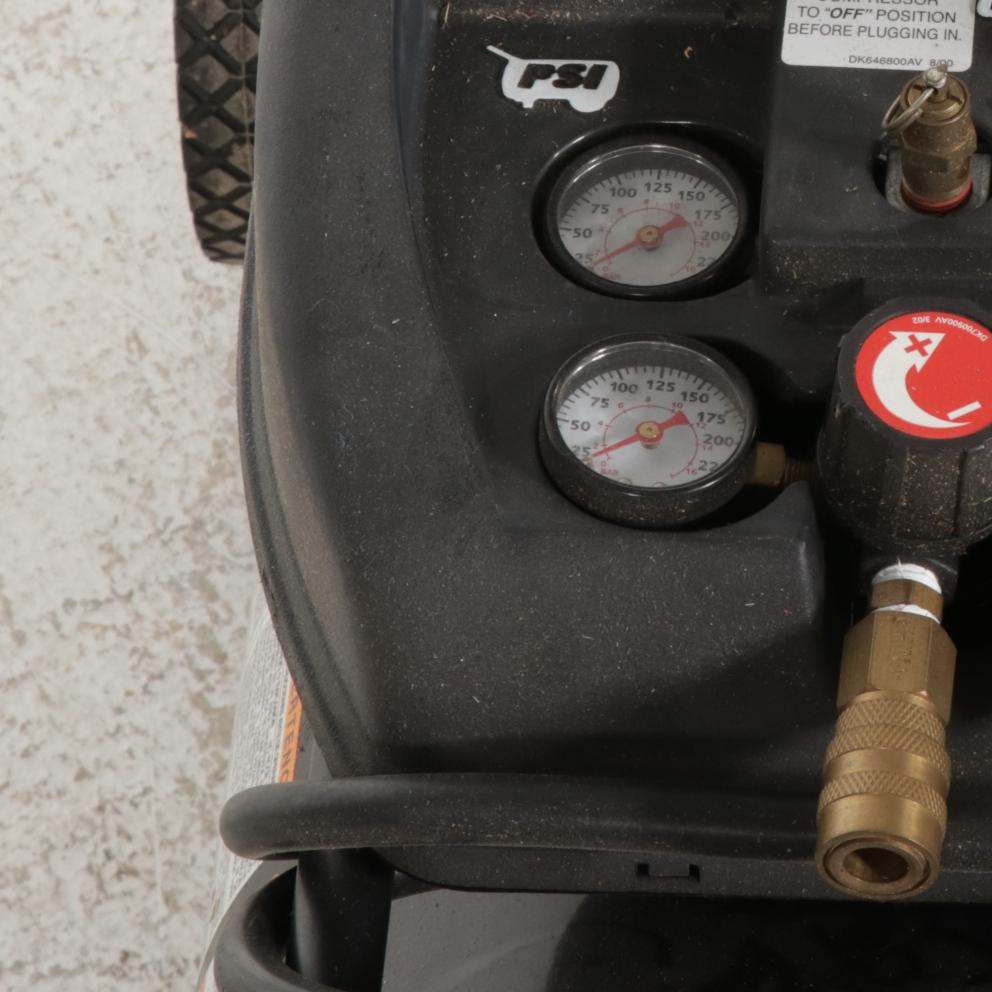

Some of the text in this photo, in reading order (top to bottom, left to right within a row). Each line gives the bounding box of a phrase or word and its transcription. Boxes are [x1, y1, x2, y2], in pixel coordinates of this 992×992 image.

[798, 6, 819, 18] TO
[876, 10, 956, 23] POSITION
[788, 23, 853, 36] BEFORE
[857, 26, 938, 40] PLUGGING
[518, 63, 608, 90] PSI
[610, 187, 637, 198] 100
[644, 183, 672, 193] 125
[678, 191, 705, 201] 150
[592, 204, 608, 214] 75
[695, 210, 721, 220] 175
[572, 228, 592, 238] 50
[702, 231, 730, 241] 200
[610, 382, 638, 393] 100
[647, 381, 676, 392] 125
[590, 397, 610, 407] 75
[680, 392, 709, 403] 150
[697, 412, 726, 424] 175
[570, 421, 590, 431] 50
[703, 434, 733, 446] 200
